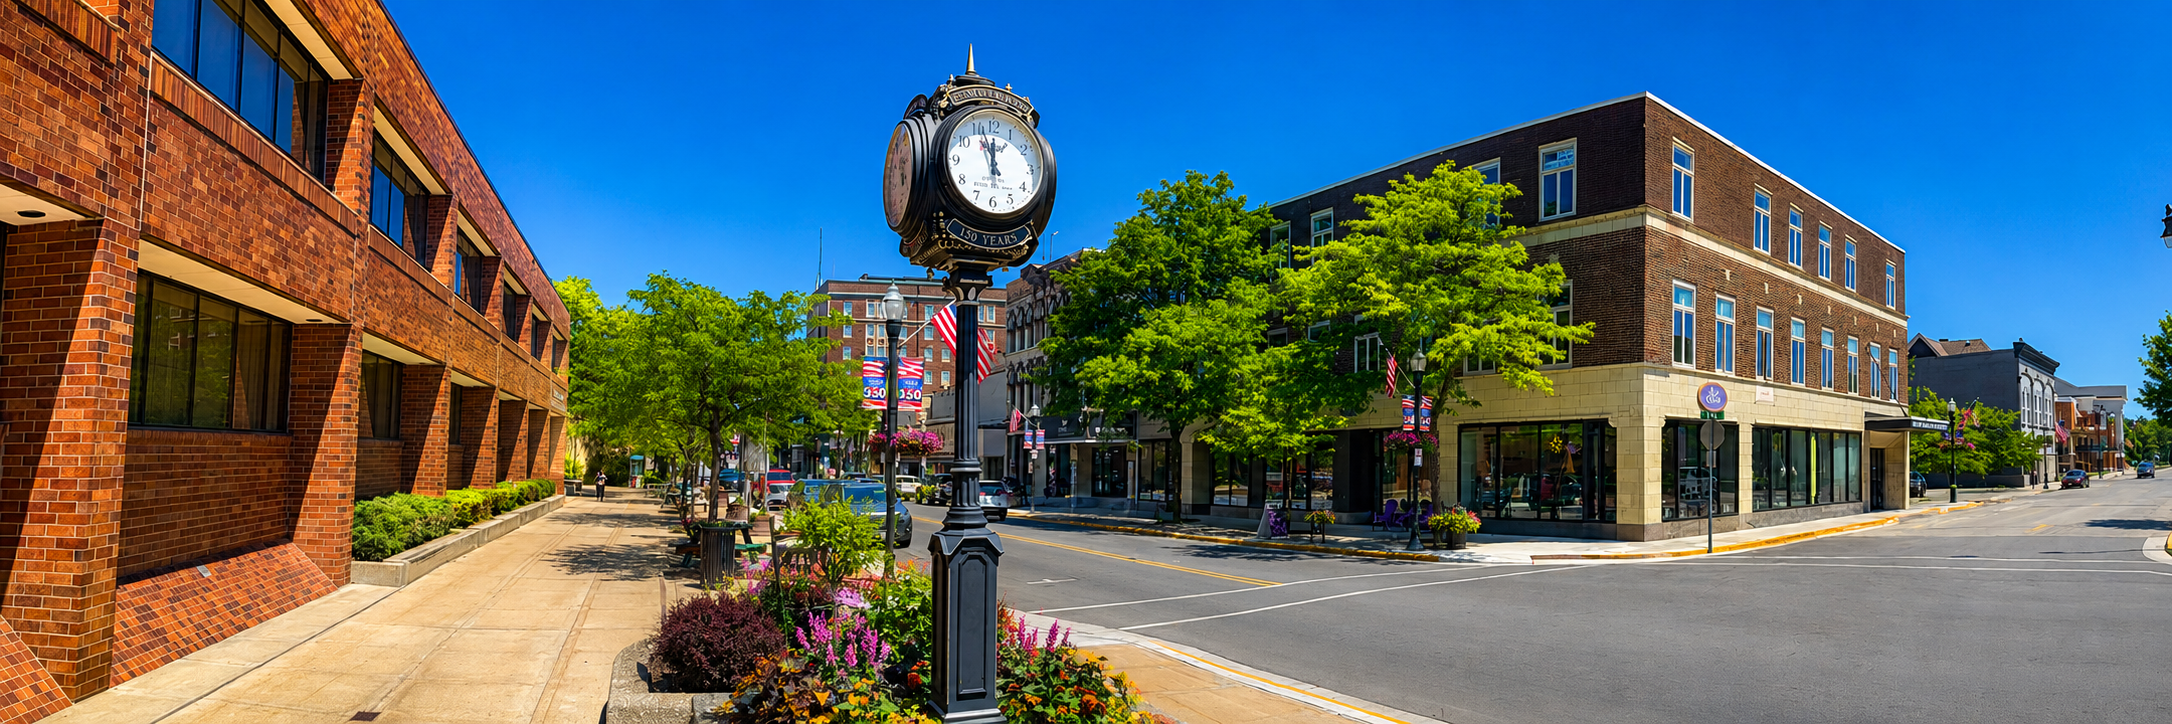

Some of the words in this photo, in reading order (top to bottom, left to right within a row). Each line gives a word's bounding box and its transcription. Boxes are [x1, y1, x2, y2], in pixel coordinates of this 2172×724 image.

[988, 120, 1000, 133] 12
[1008, 129, 1012, 140] 1
[959, 135, 970, 148] 10
[1020, 144, 1028, 156] 2
[952, 154, 960, 165] 9
[1026, 163, 1034, 175] 3
[958, 173, 966, 185] 8
[1019, 181, 1027, 192] 4
[972, 189, 980, 201] 7
[1006, 193, 1014, 205] 5
[989, 195, 997, 208] 6
[960, 228, 978, 242] 150
[982, 233, 1018, 246] YEARS
